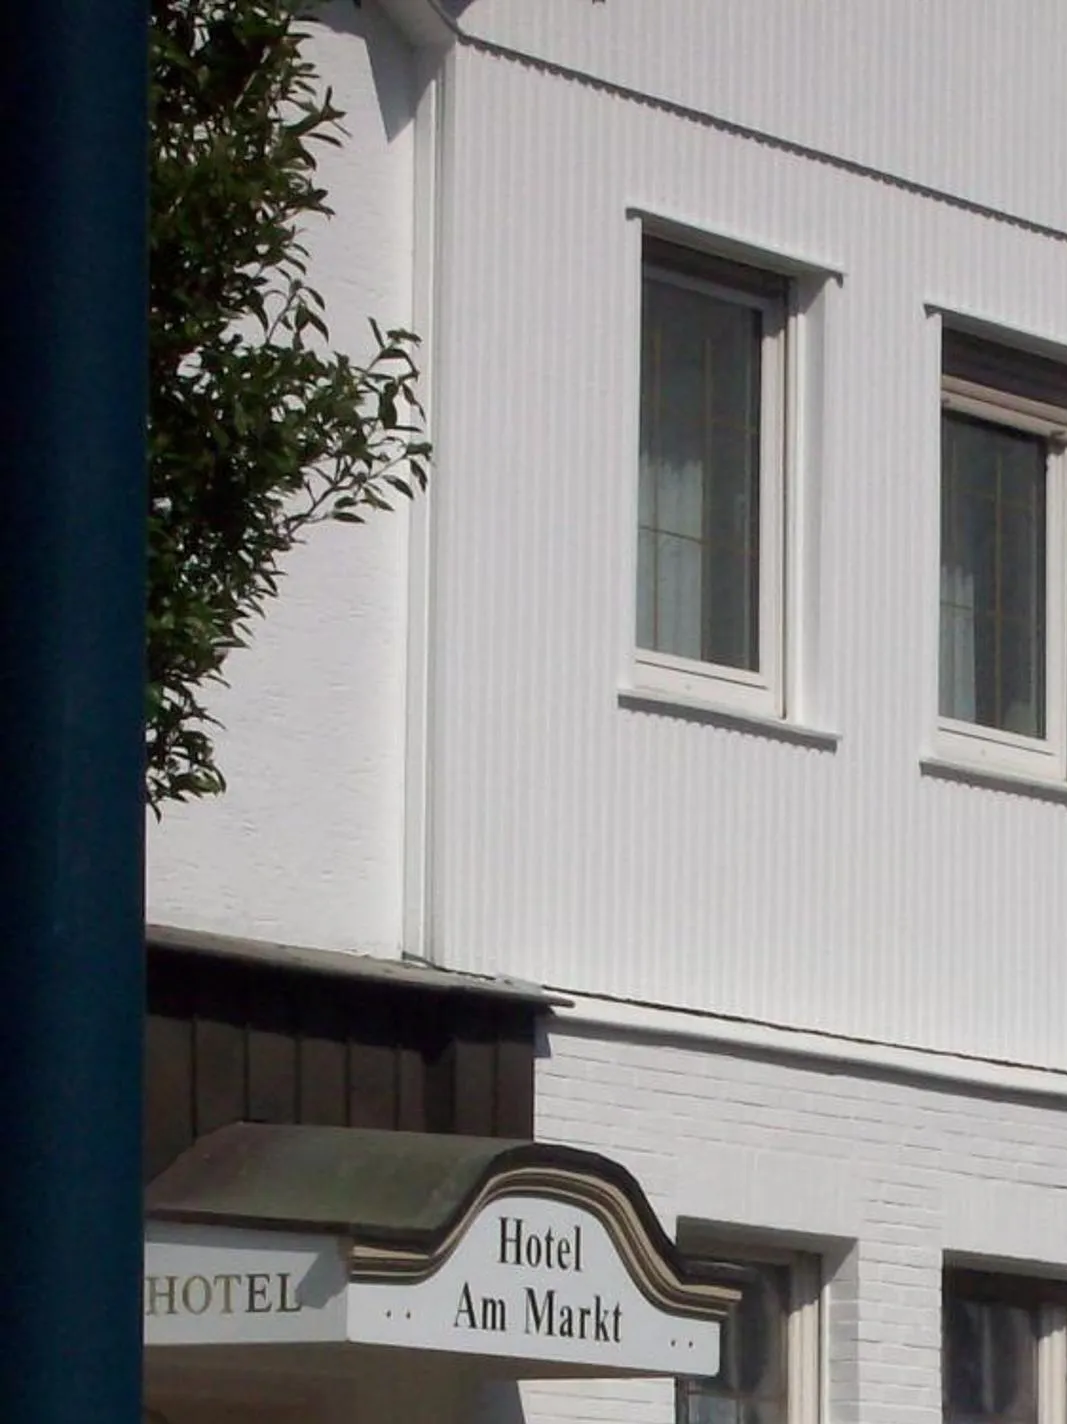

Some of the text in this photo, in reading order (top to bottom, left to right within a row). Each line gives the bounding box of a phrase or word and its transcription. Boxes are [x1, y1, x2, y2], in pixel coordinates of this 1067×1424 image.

[498, 1215, 582, 1272] Hotel
[144, 1272, 302, 1315] HOTEL
[454, 1281, 622, 1343] Am Markt
